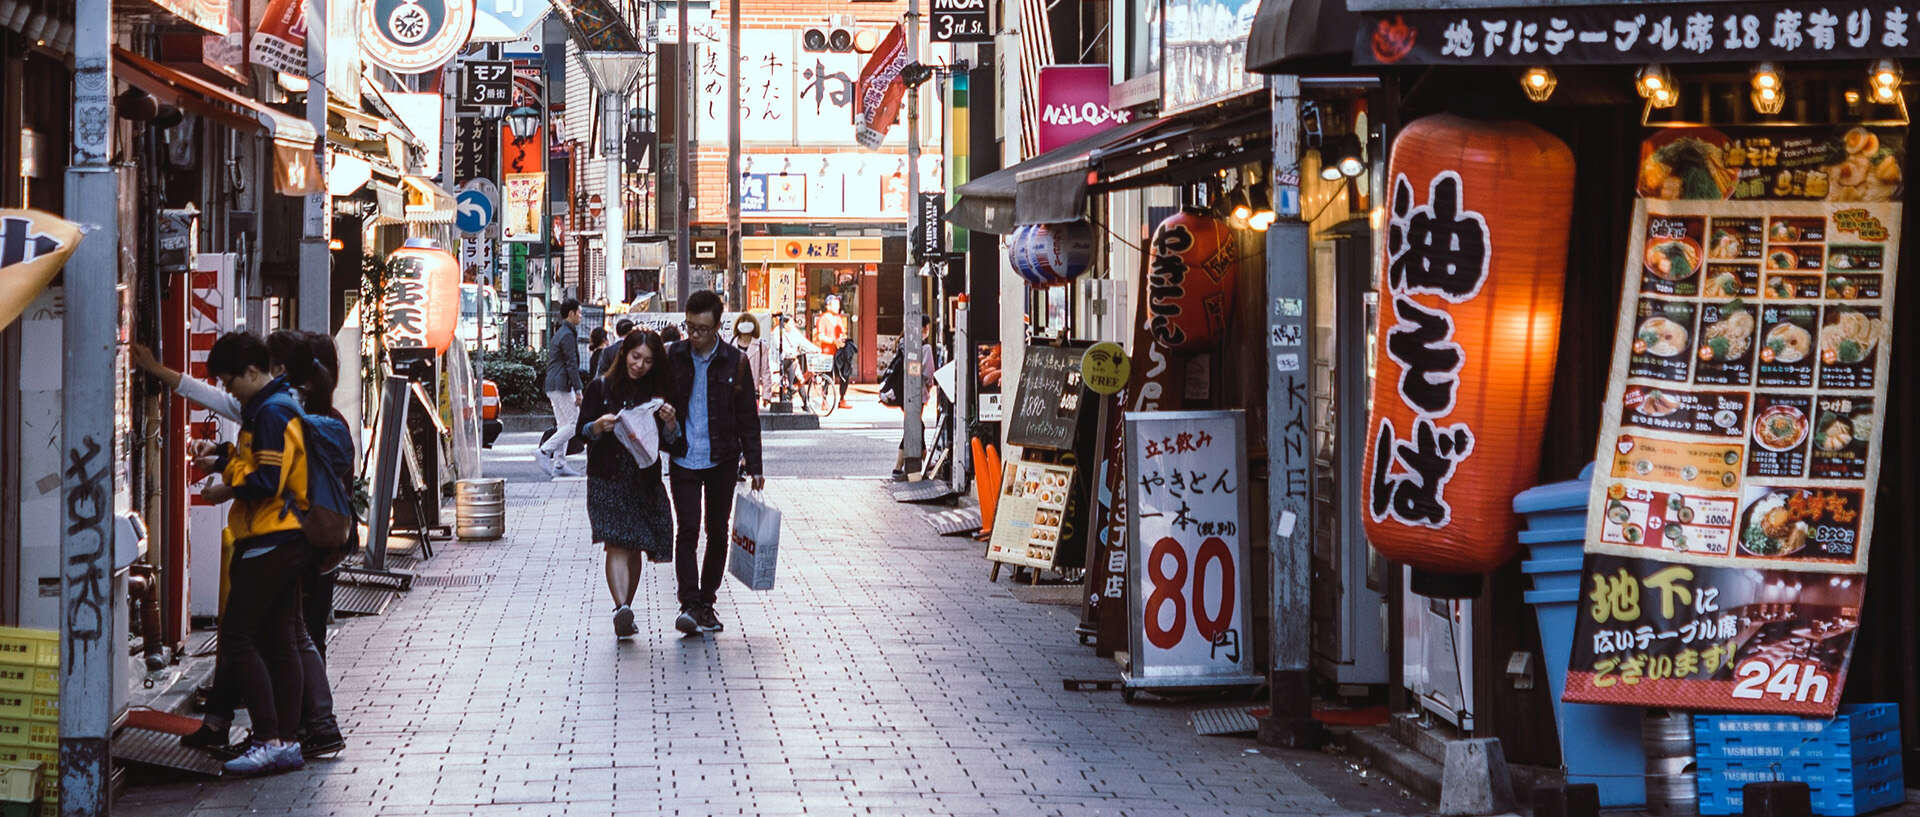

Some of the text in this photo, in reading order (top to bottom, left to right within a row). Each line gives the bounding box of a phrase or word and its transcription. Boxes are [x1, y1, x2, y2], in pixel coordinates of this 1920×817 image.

[937, 15, 984, 40] 3rd St.
[474, 65, 506, 81] モア
[760, 52, 783, 119] 牛たん
[473, 84, 506, 103] 3番街
[807, 243, 839, 257] 松屋
[1150, 223, 1194, 347] やきとん
[1370, 171, 1491, 529] 油そば
[1145, 430, 1213, 459] 立ち飲み
[1139, 467, 1239, 498] やきとん
[1139, 500, 1198, 532] 一本
[1143, 536, 1235, 650] 80
[1593, 615, 1738, 654] 広いテーブル席
[1592, 643, 1738, 688] ございます!
[1732, 661, 1829, 703] 24h
